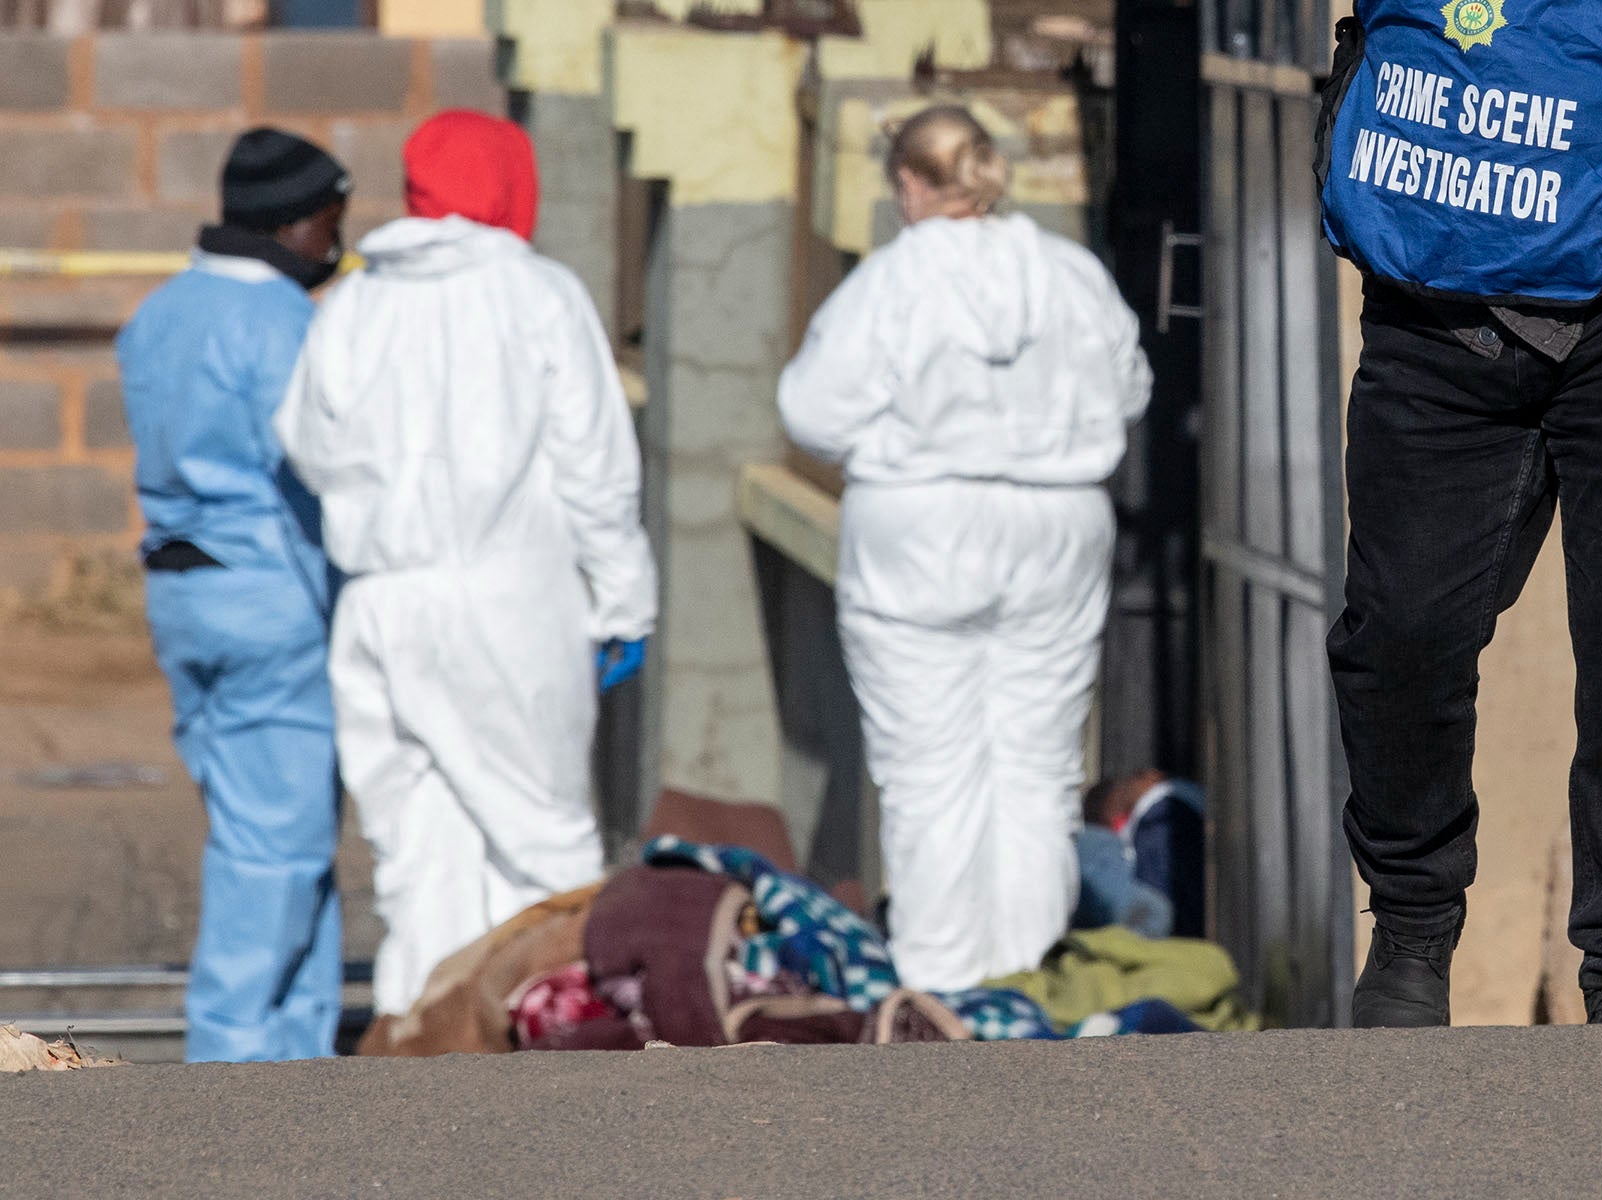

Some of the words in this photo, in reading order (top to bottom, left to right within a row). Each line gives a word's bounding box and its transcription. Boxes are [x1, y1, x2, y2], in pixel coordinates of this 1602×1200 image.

[1376, 61, 1453, 129] CRIME
[1458, 84, 1578, 151] SCENE
[1348, 128, 1562, 224] INVESTIGATOR
